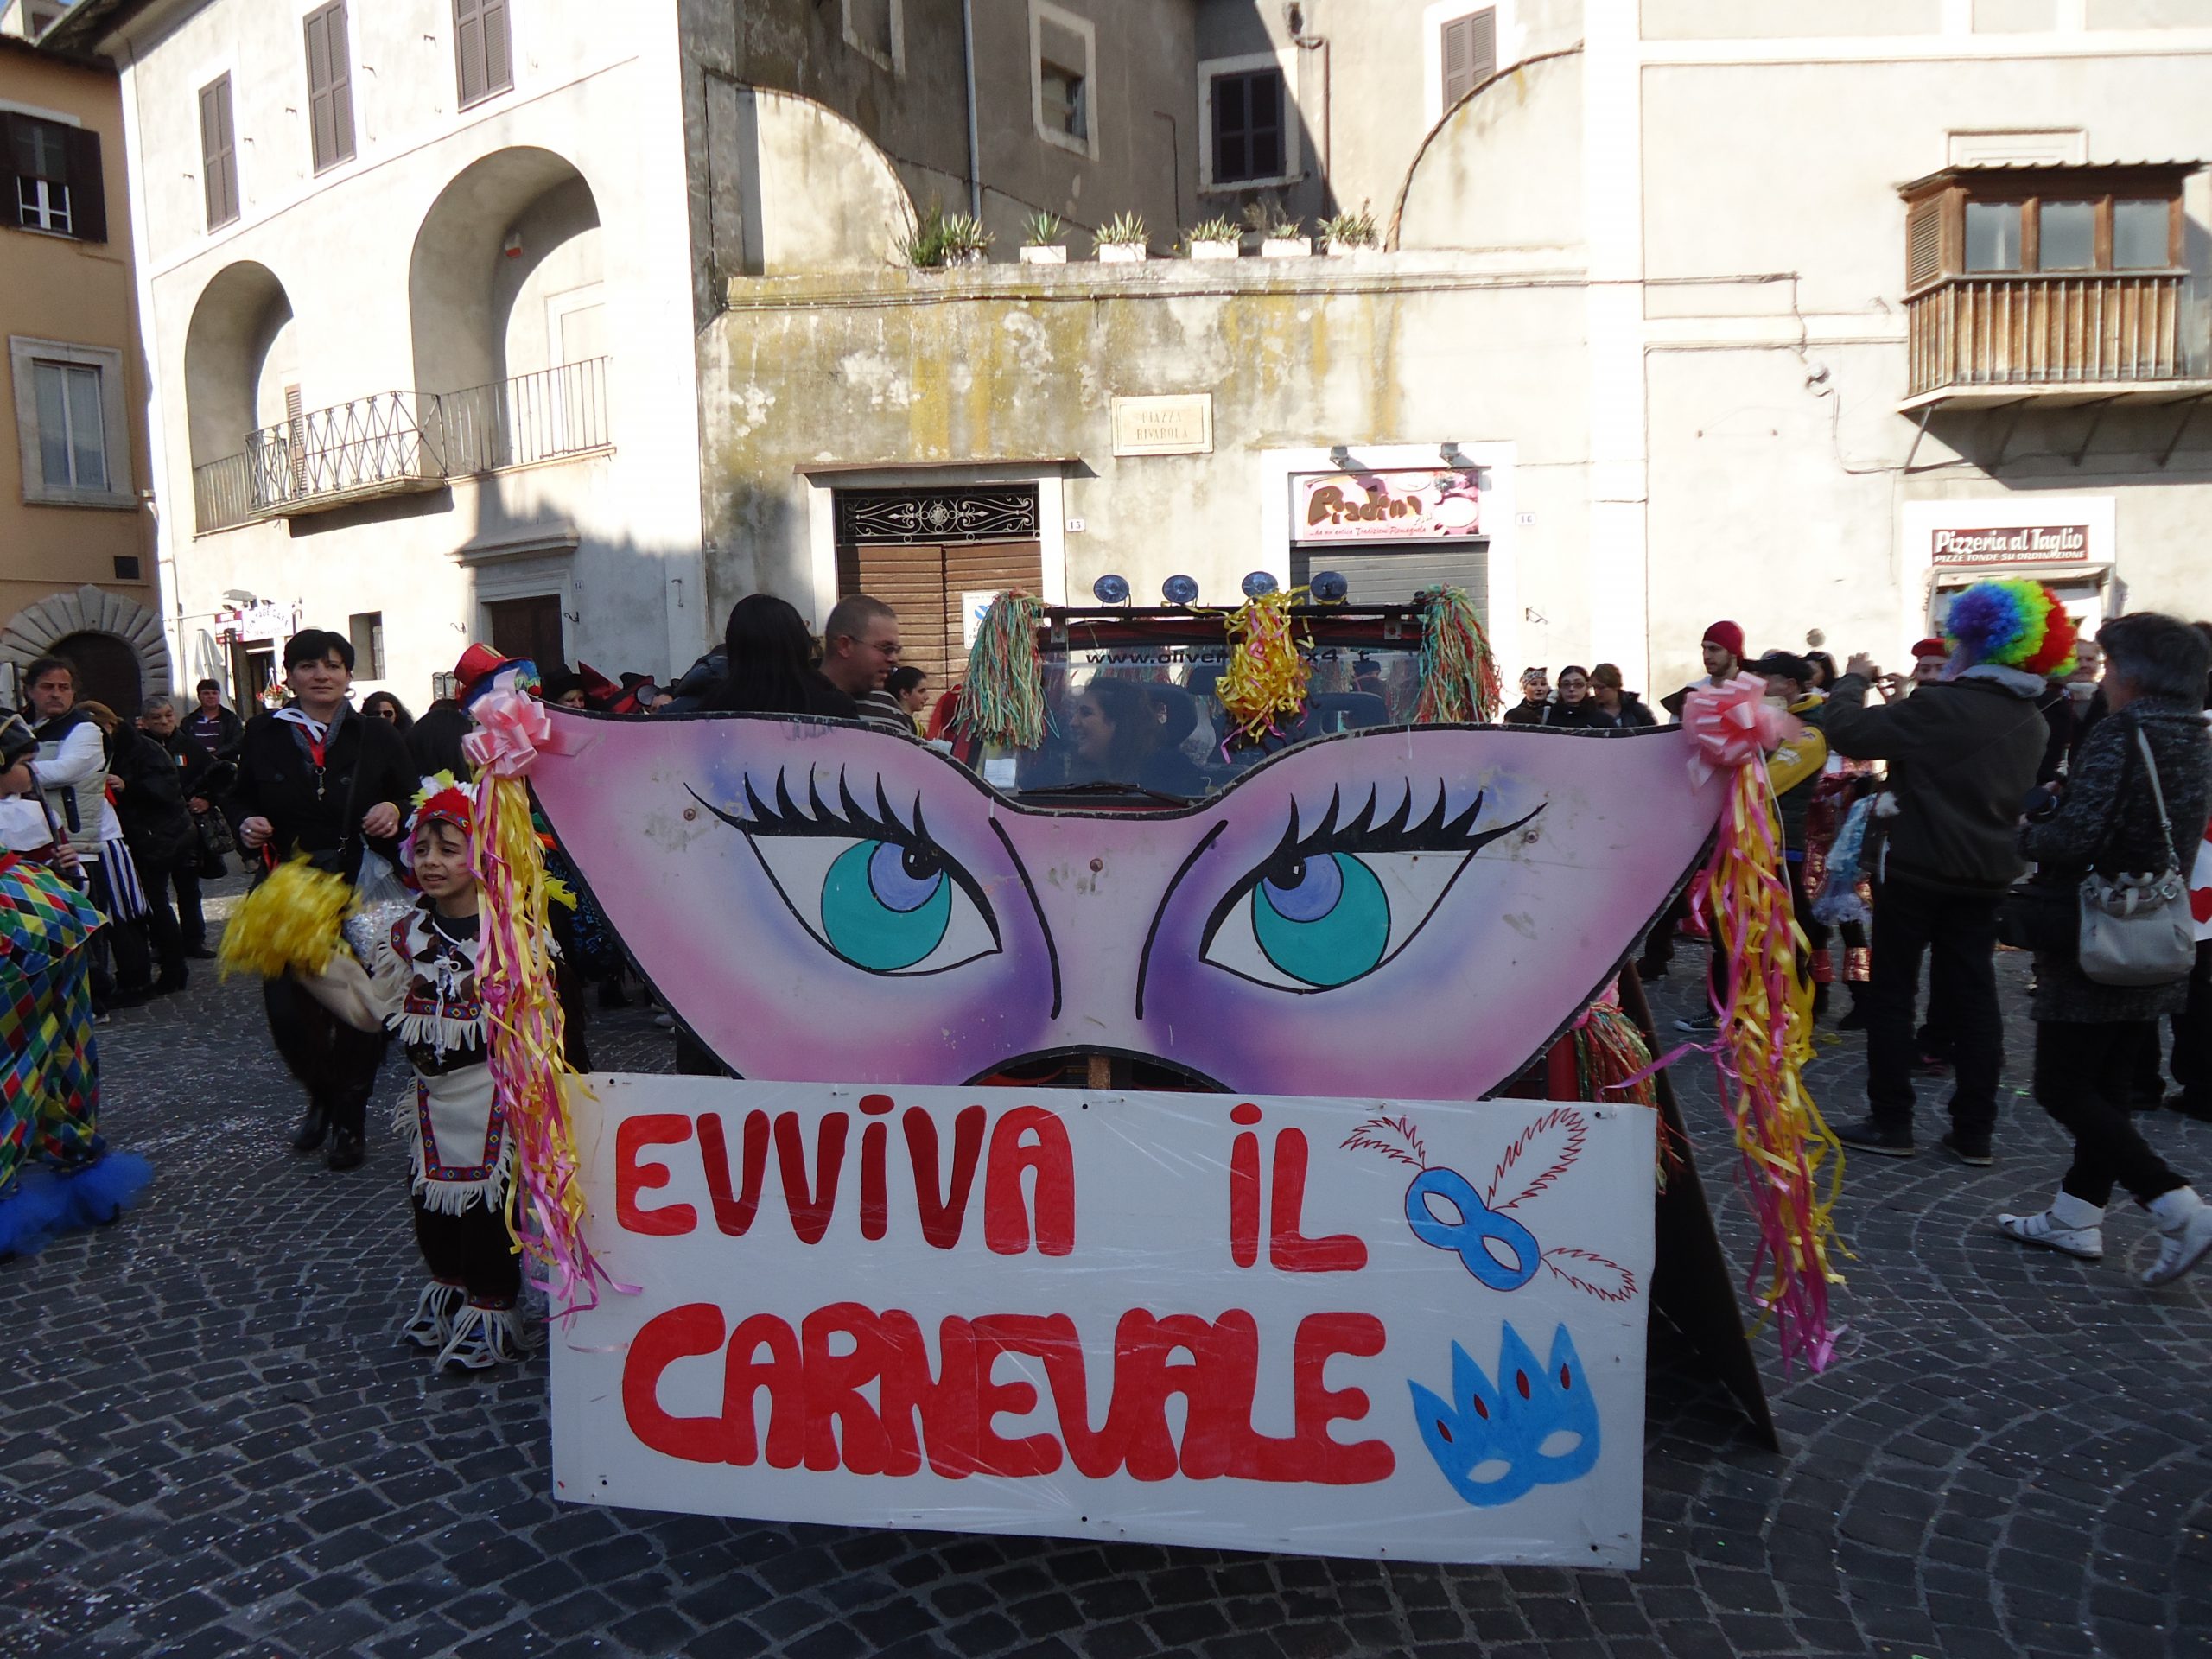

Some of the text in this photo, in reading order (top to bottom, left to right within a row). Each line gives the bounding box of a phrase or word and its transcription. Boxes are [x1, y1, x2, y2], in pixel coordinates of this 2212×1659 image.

[1141, 409, 1182, 423] PIAZZA
[1136, 427, 1189, 442] RIVAROLA
[1935, 528, 2084, 557] Pizzeria al Taglio
[1935, 554, 1965, 563] PIZZE
[1967, 553, 1999, 562] TONDE
[2017, 550, 2086, 561] ORDINAZIONE
[621, 1300, 1396, 1485] CARNEVALE
